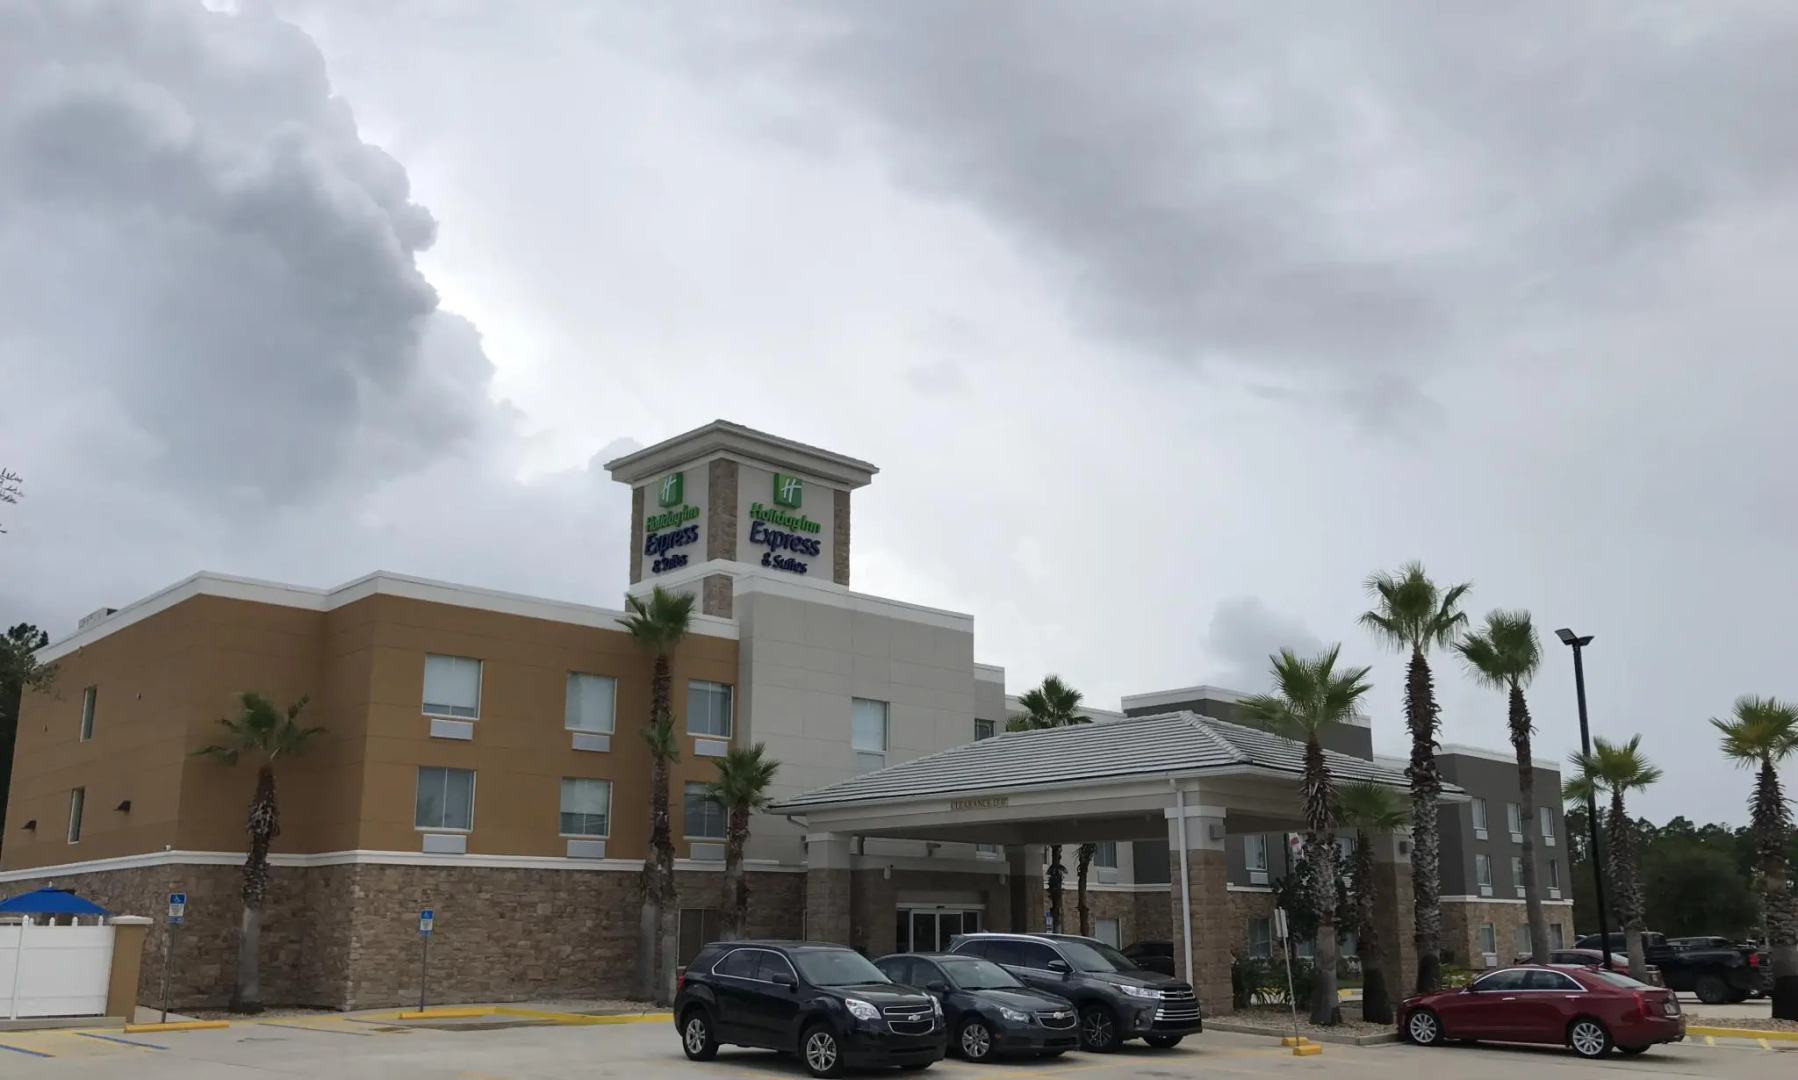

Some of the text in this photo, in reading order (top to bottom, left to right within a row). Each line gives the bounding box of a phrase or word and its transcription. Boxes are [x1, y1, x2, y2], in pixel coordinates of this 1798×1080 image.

[644, 524, 699, 557] Express
[749, 520, 822, 557] Express
[652, 555, 689, 574] & Suites
[761, 553, 808, 574] & Suites
